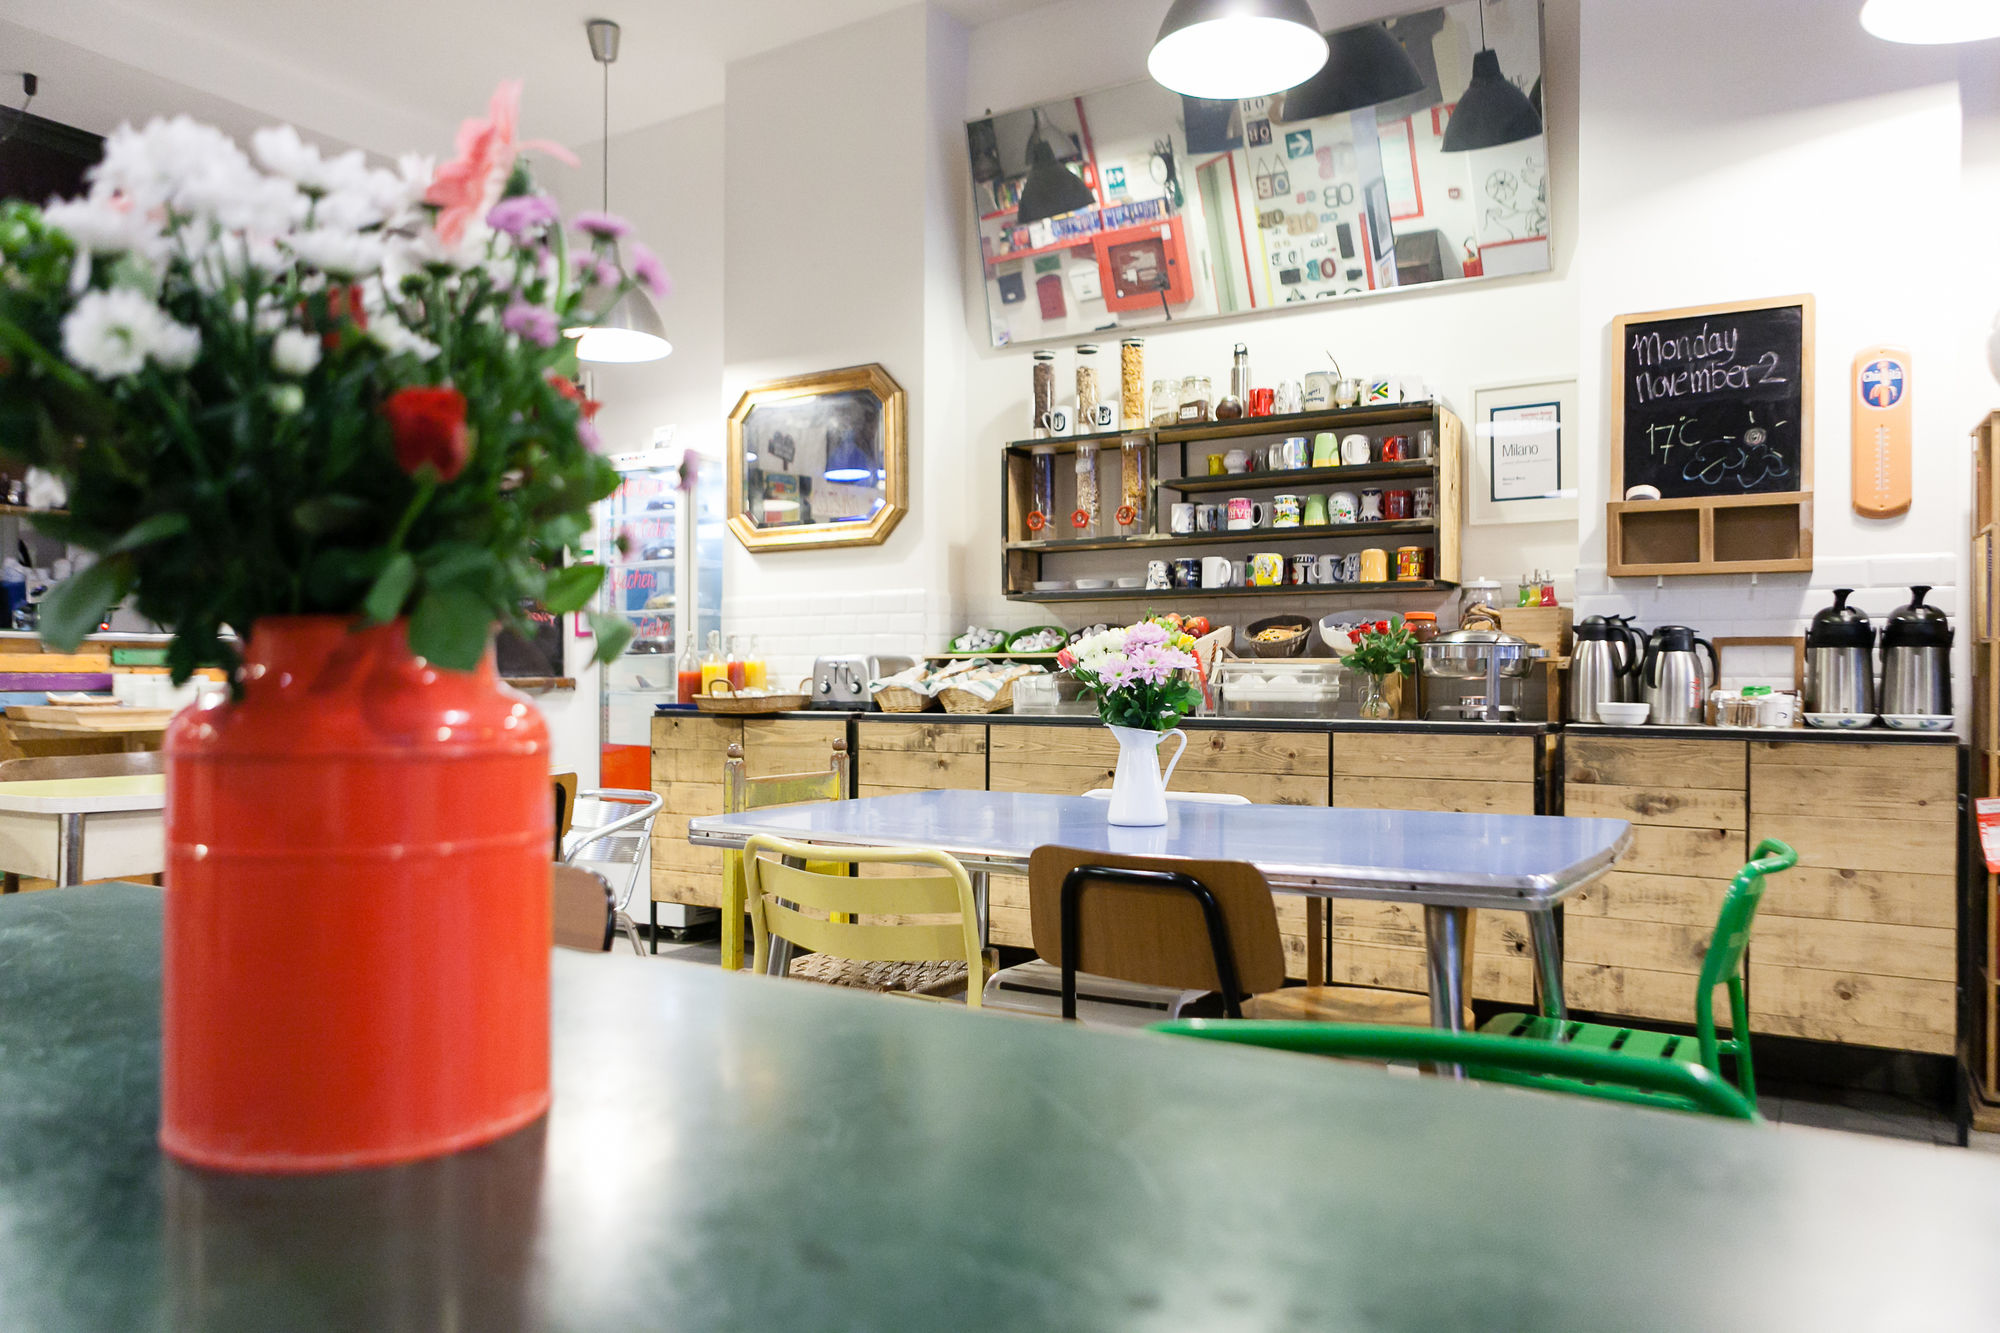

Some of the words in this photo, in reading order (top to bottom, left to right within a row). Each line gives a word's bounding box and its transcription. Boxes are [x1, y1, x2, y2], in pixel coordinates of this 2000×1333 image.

[1632, 322, 1738, 366] Monday
[1758, 351, 1788, 383] 2
[1502, 444, 1539, 457] Milano
[640, 617, 672, 638] Cake
